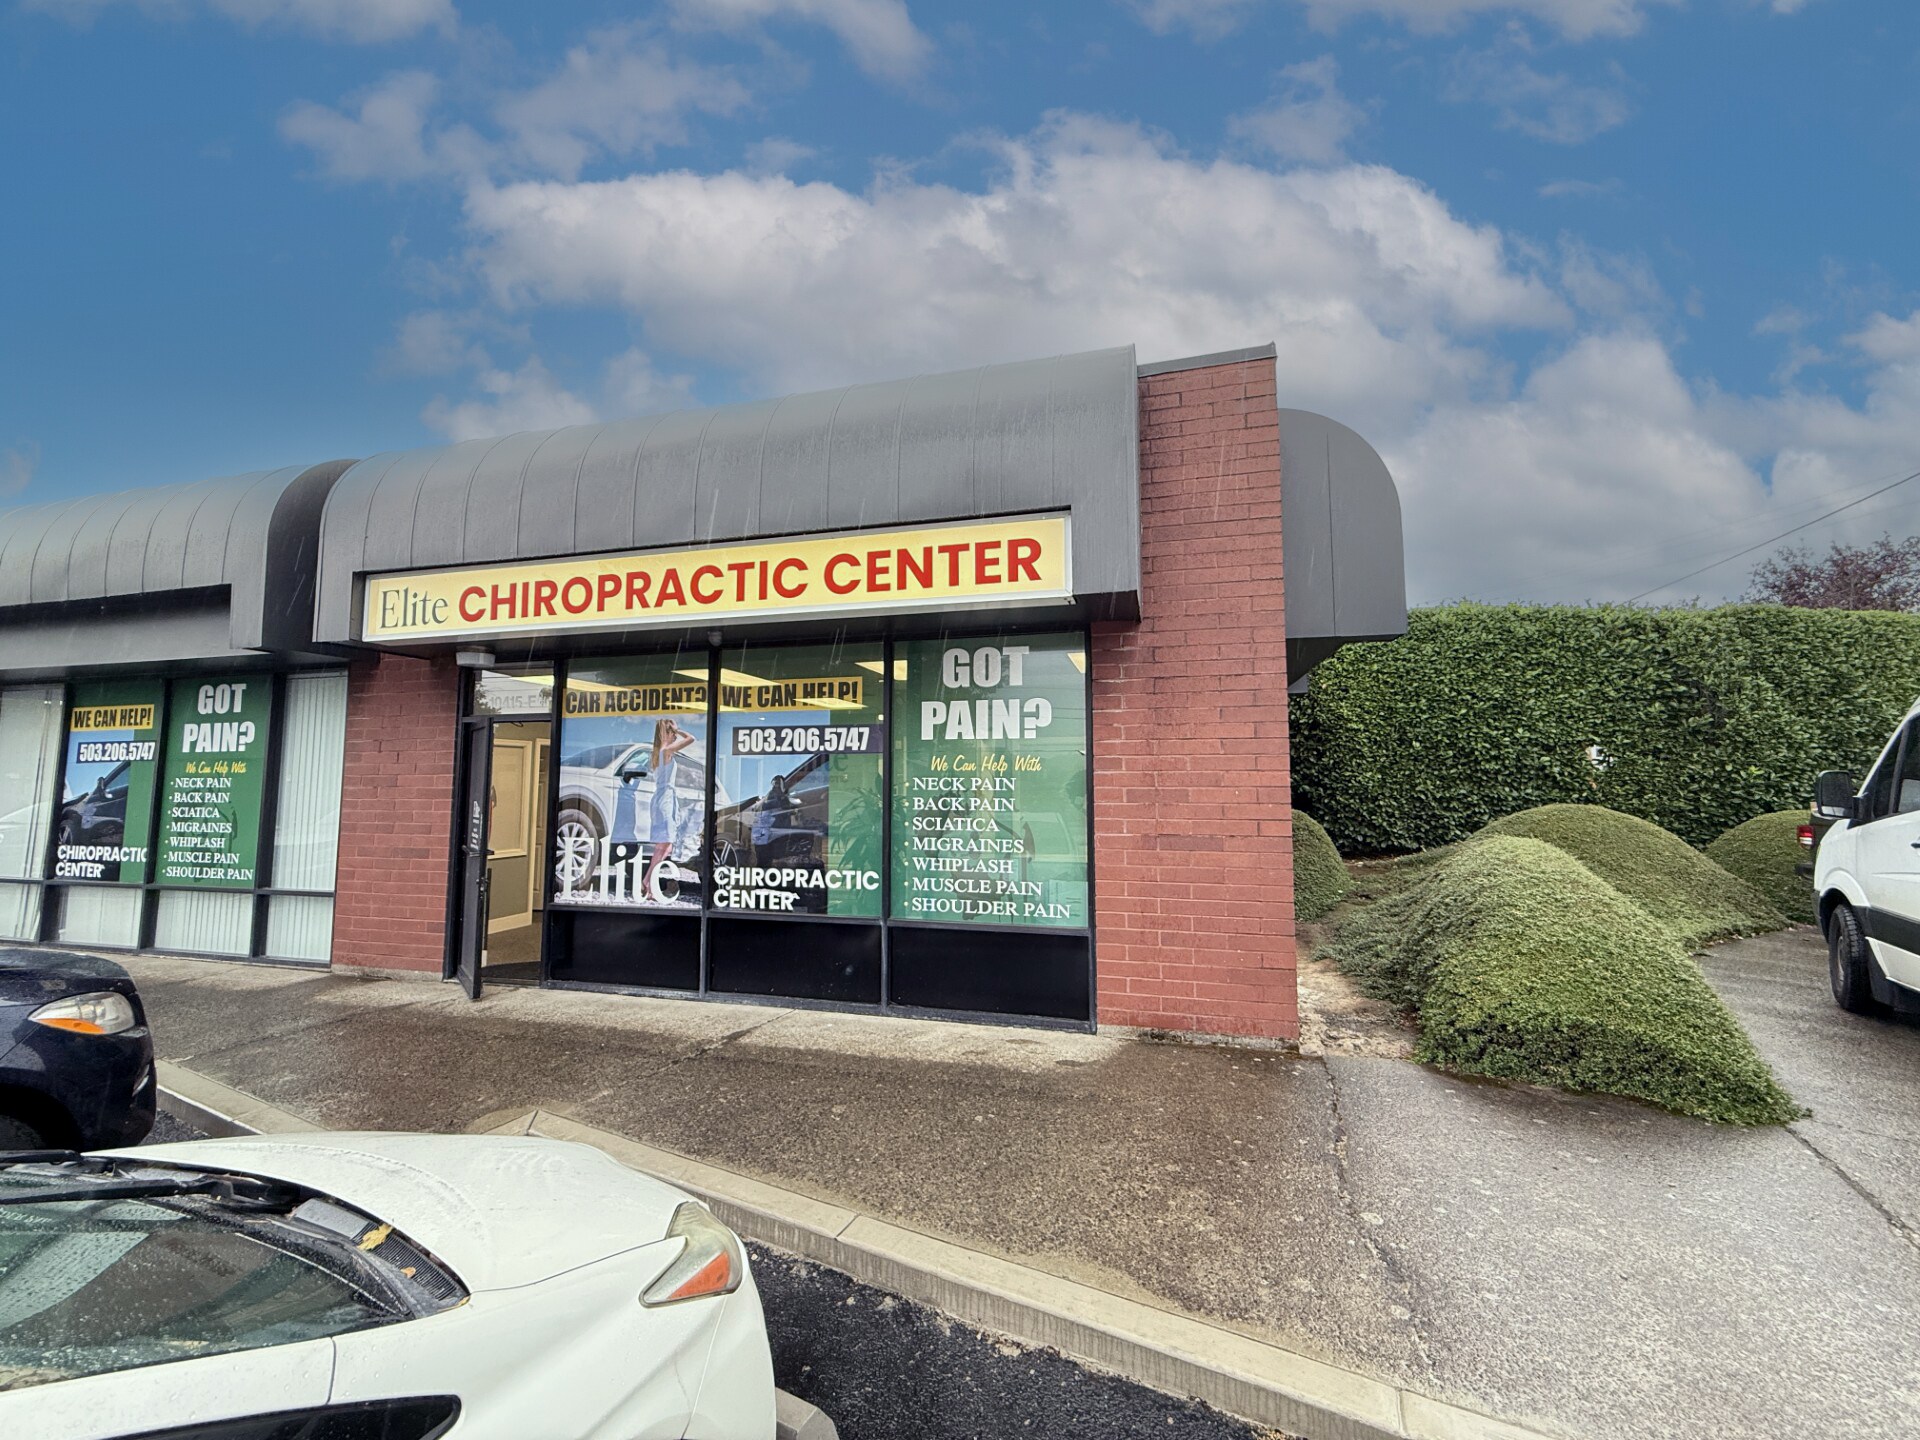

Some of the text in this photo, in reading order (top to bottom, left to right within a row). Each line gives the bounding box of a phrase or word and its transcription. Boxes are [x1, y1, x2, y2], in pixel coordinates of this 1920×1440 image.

[380, 538, 1042, 629] Elite CHIROPRACTIC CENTER
[942, 646, 1029, 688] GOT
[197, 684, 246, 715] GOT
[565, 686, 707, 713] CAR ACCIDENT?
[722, 681, 858, 708] WE CAN HELP!
[74, 707, 152, 728] WE CAN HELP!
[921, 698, 1052, 740] PAIN?
[182, 721, 255, 753] PAIN?
[737, 727, 870, 752] 503.206.5747
[79, 741, 155, 762] 503.206.5747
[931, 753, 1042, 777] We Can Help With
[175, 777, 232, 788] NECK PAIN
[912, 777, 1016, 791] NECK PAIN
[173, 792, 230, 803] BACK PAIN
[912, 797, 1015, 811] BACK PAIN
[171, 807, 220, 818] SCIATICA
[170, 822, 232, 834] MIGRAINES
[912, 816, 1000, 832] SCIATICA
[169, 837, 226, 849] WHIPLASH
[912, 836, 1024, 853] MIGRAINES
[57, 845, 148, 863] CHIROPRACTIC
[168, 851, 240, 865] MUSCLE PAIN
[55, 861, 103, 878] CENTER
[166, 866, 254, 880] SHOULDER PAIN
[562, 834, 681, 905] Elite
[912, 857, 1014, 874] WHIPLASH
[713, 866, 880, 891] CHIROPRACTIC
[912, 877, 1043, 896] MUSCLE PAIN
[713, 888, 796, 911] CENTER
[912, 897, 1071, 919] SHOULDER PAIN
